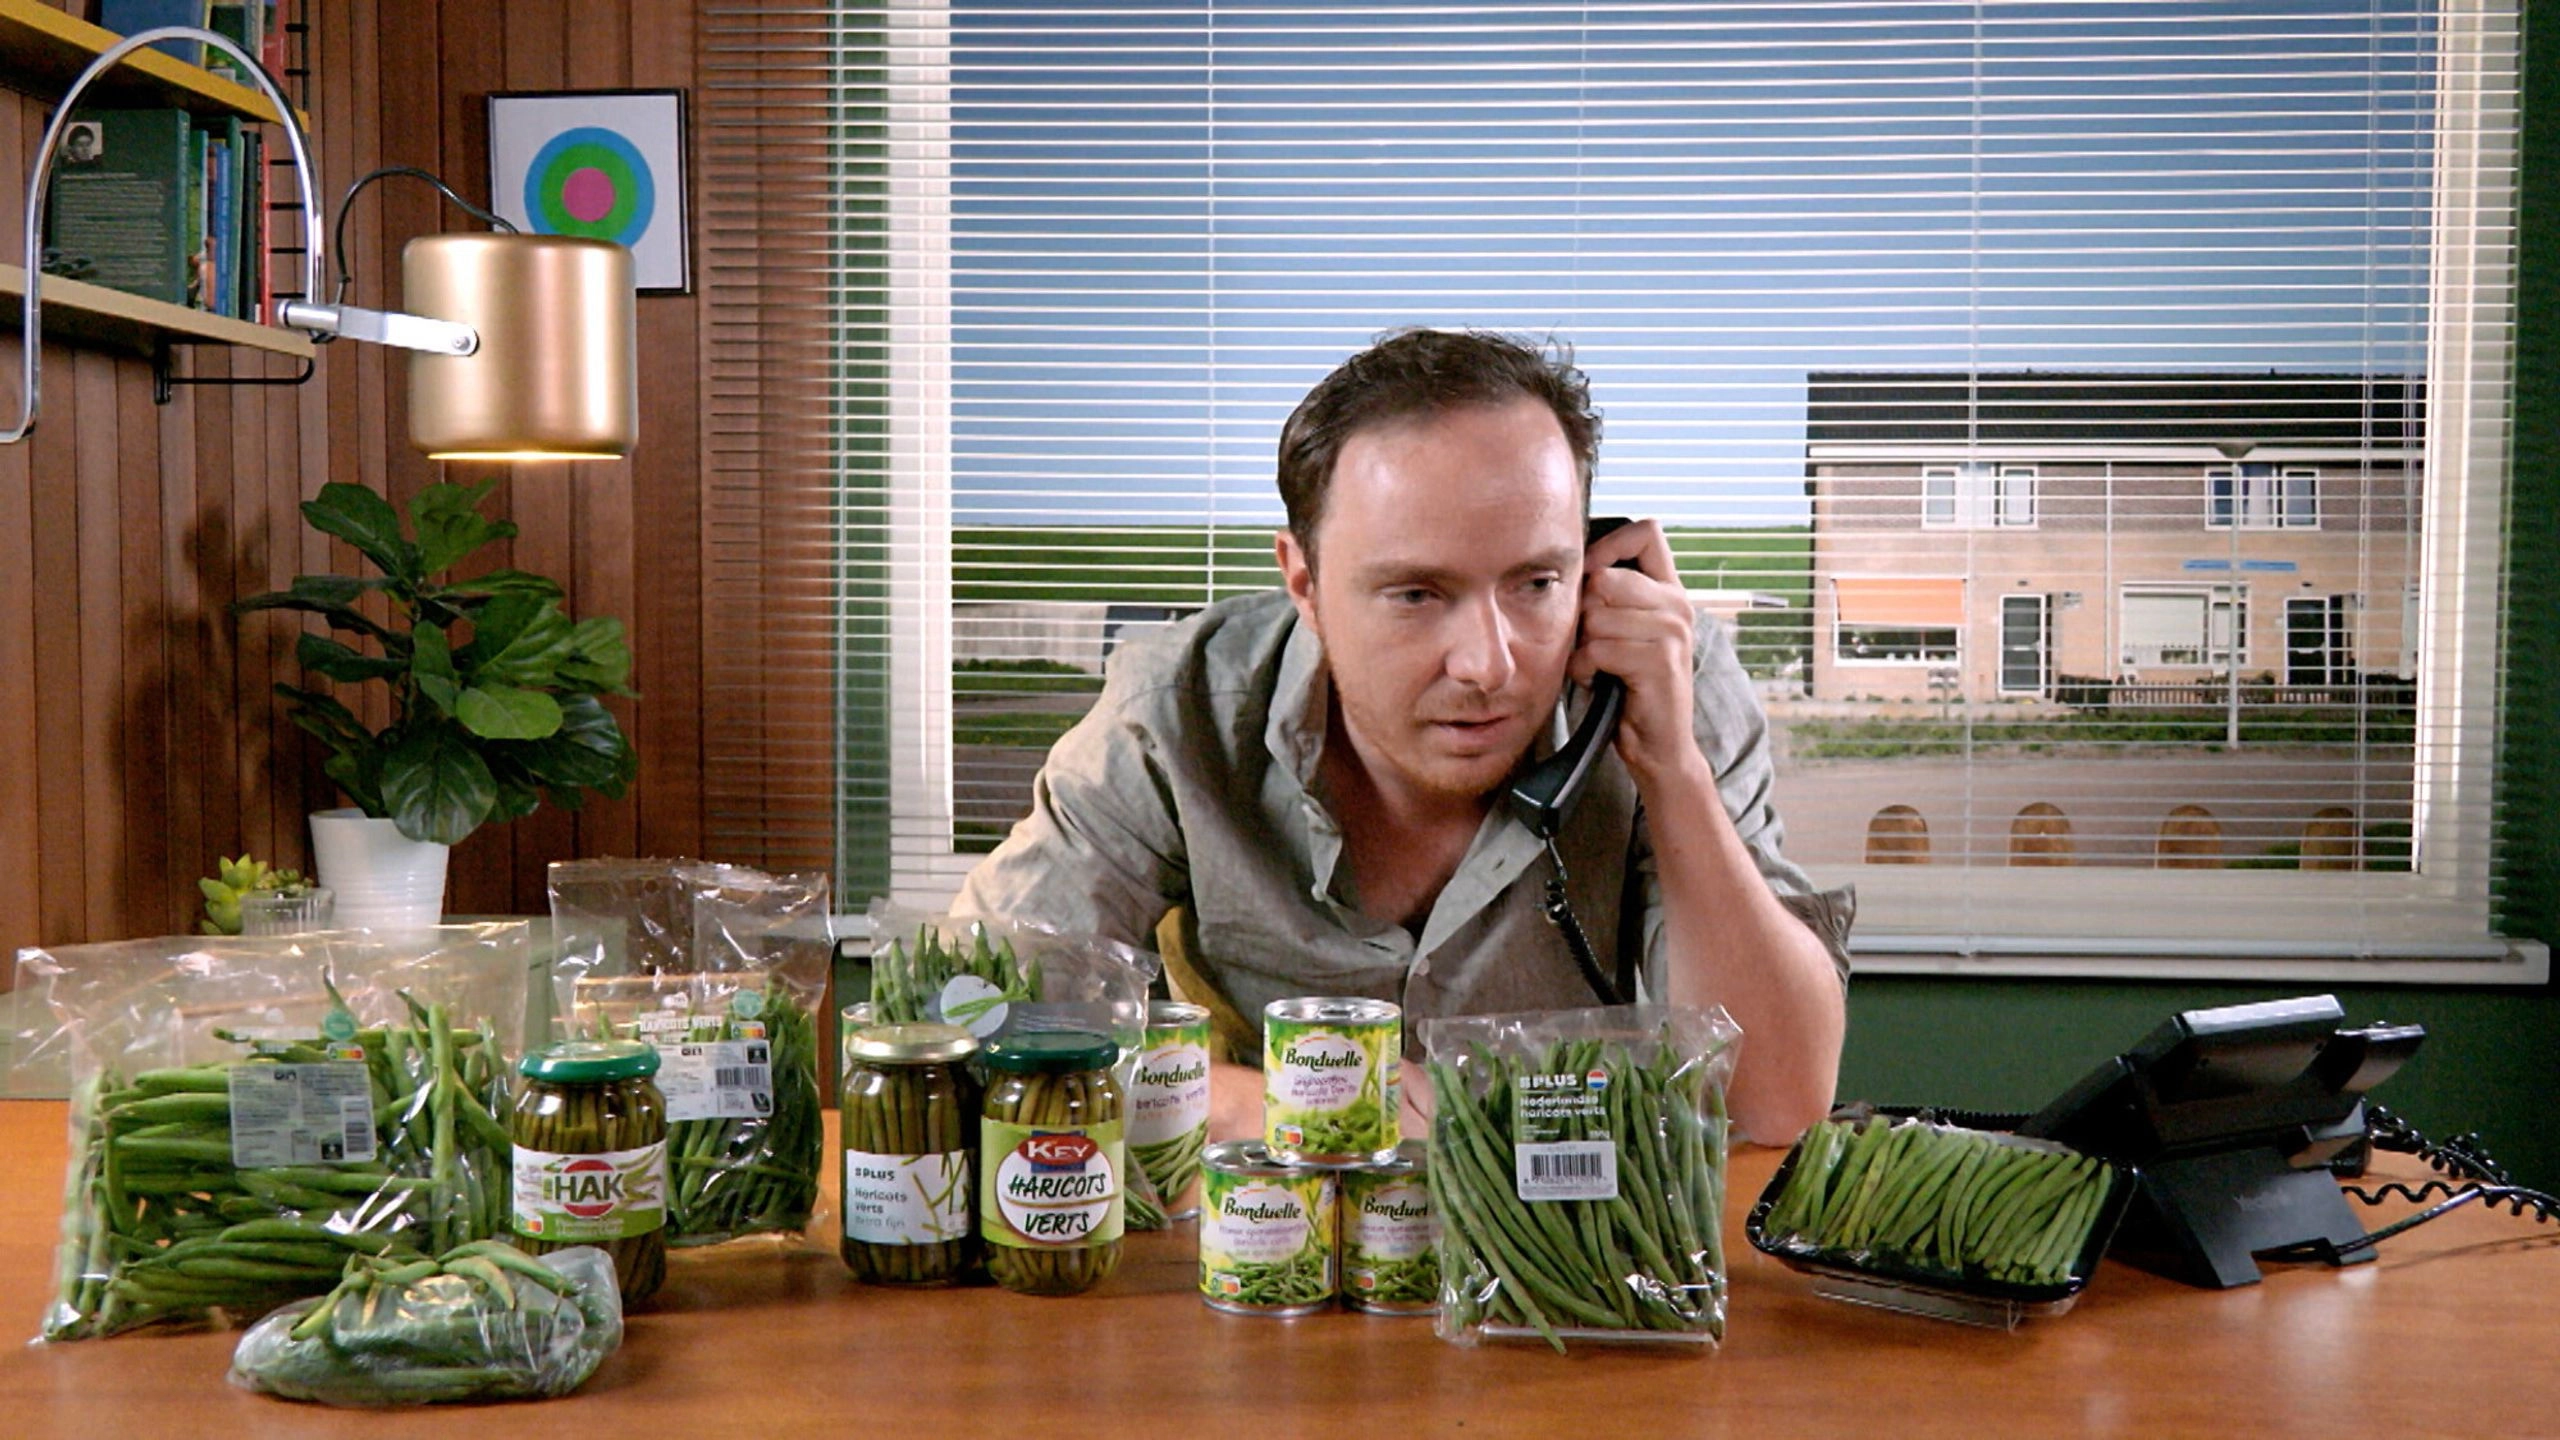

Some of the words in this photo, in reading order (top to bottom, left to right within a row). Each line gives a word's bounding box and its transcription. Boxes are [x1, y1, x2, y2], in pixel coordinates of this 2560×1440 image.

[1284, 1047, 1362, 1072] Bonduelle
[1532, 1074, 1577, 1088] PLUS
[1520, 1096, 1598, 1108] Nederlandse
[862, 1168, 895, 1181] PLUS
[1008, 1173, 1106, 1199] HARICOTS
[555, 1173, 625, 1202] HAK
[1224, 1197, 1301, 1223] Bonduelle
[1024, 1213, 1090, 1235] VERTS
